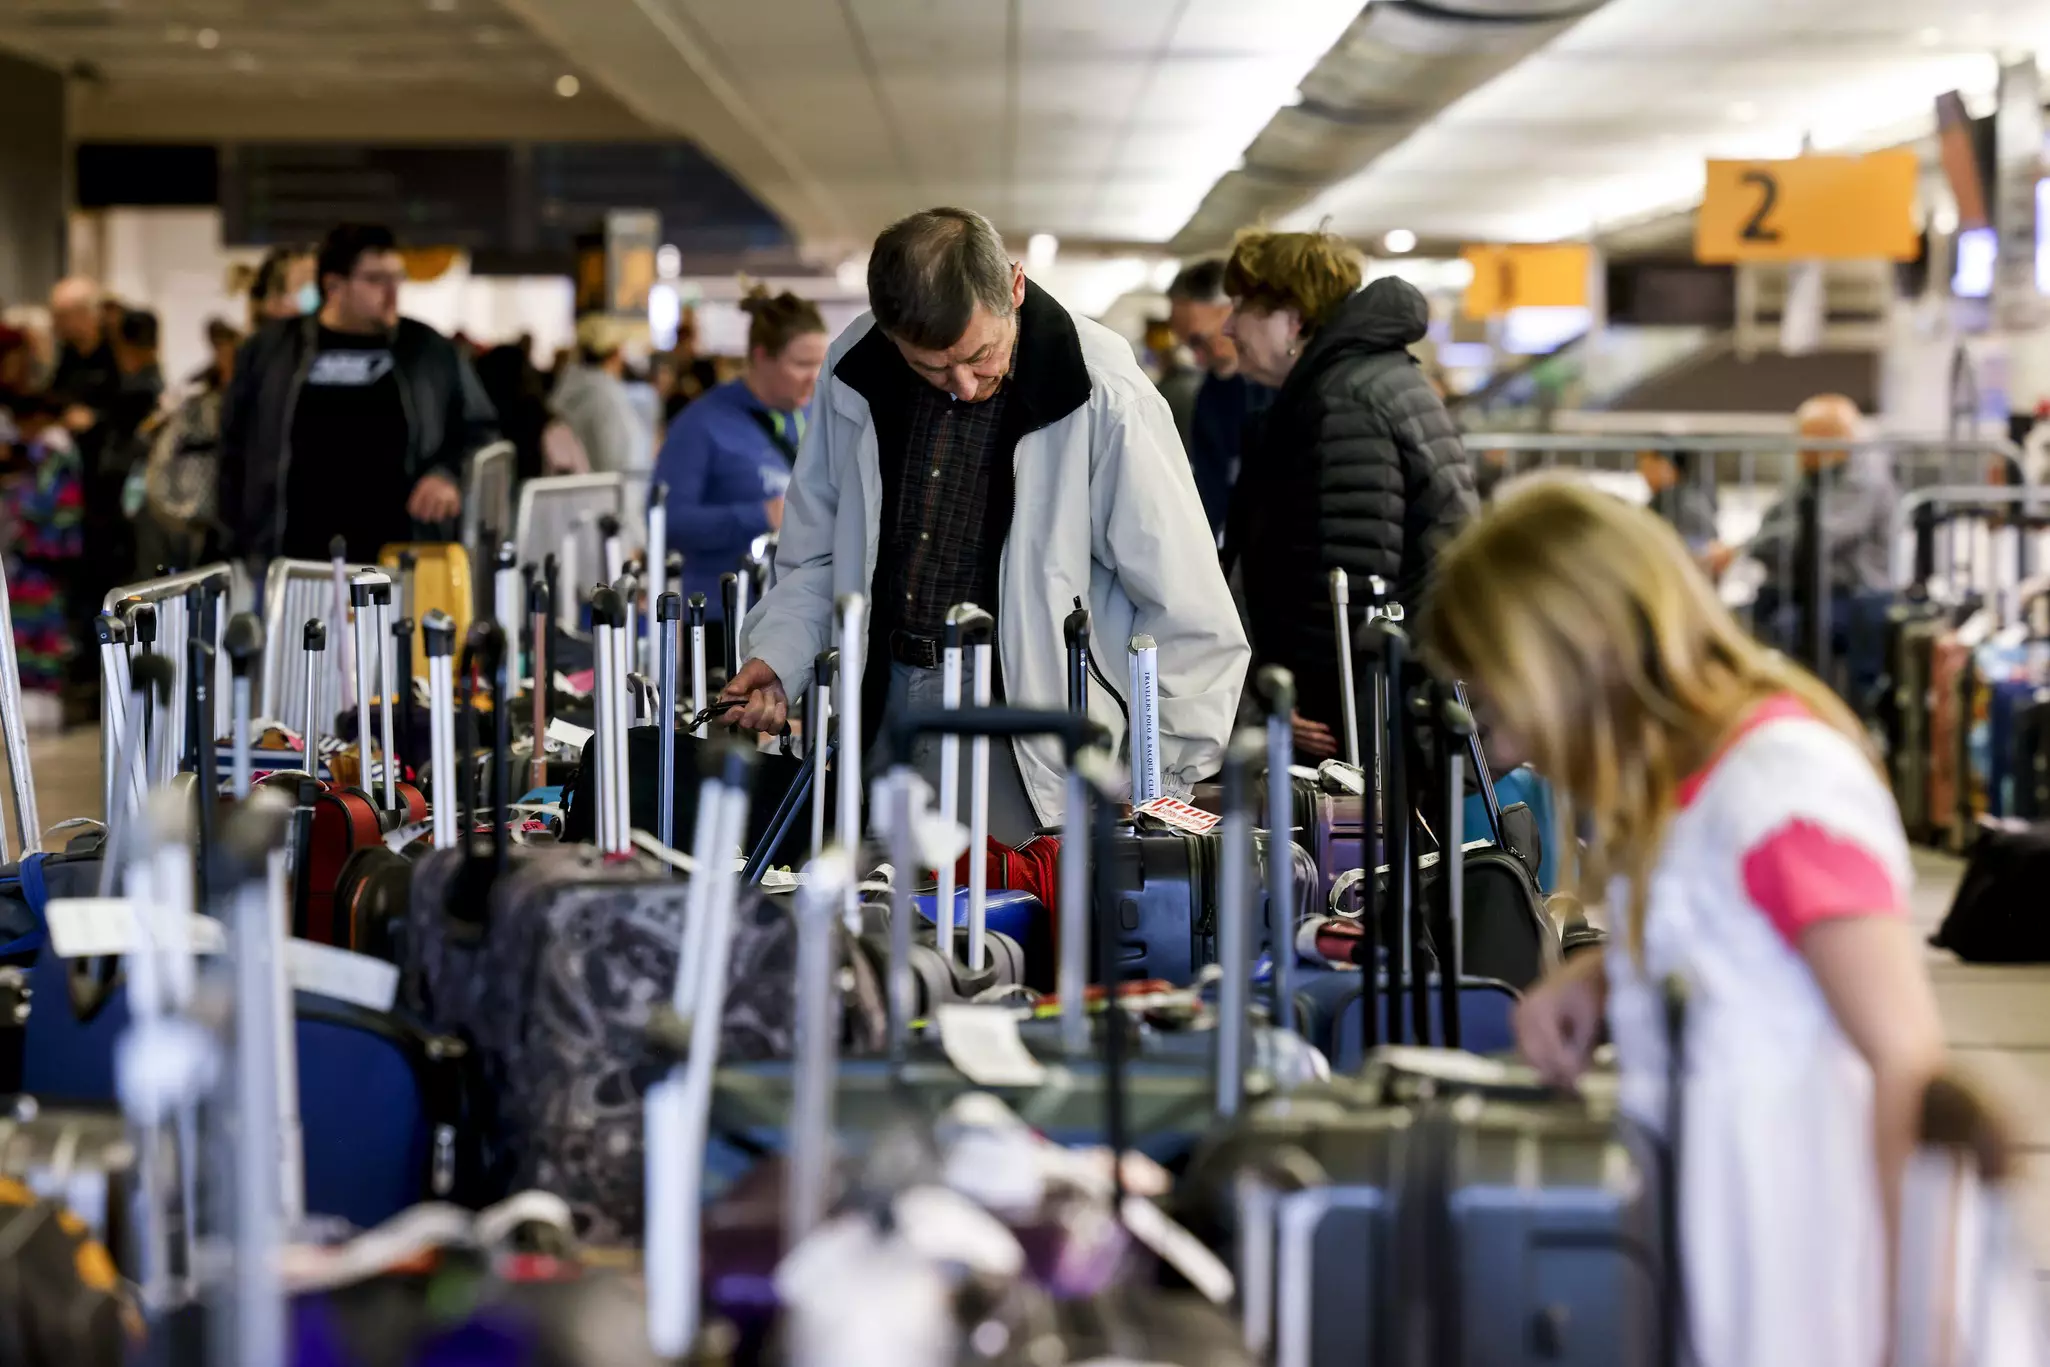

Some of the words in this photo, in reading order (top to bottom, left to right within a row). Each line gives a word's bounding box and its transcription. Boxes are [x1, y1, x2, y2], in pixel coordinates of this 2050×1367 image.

[1740, 170, 1781, 241] 2
[1144, 672, 1152, 712] TRAVELERS
[1146, 743, 1154, 776] RACQUET
